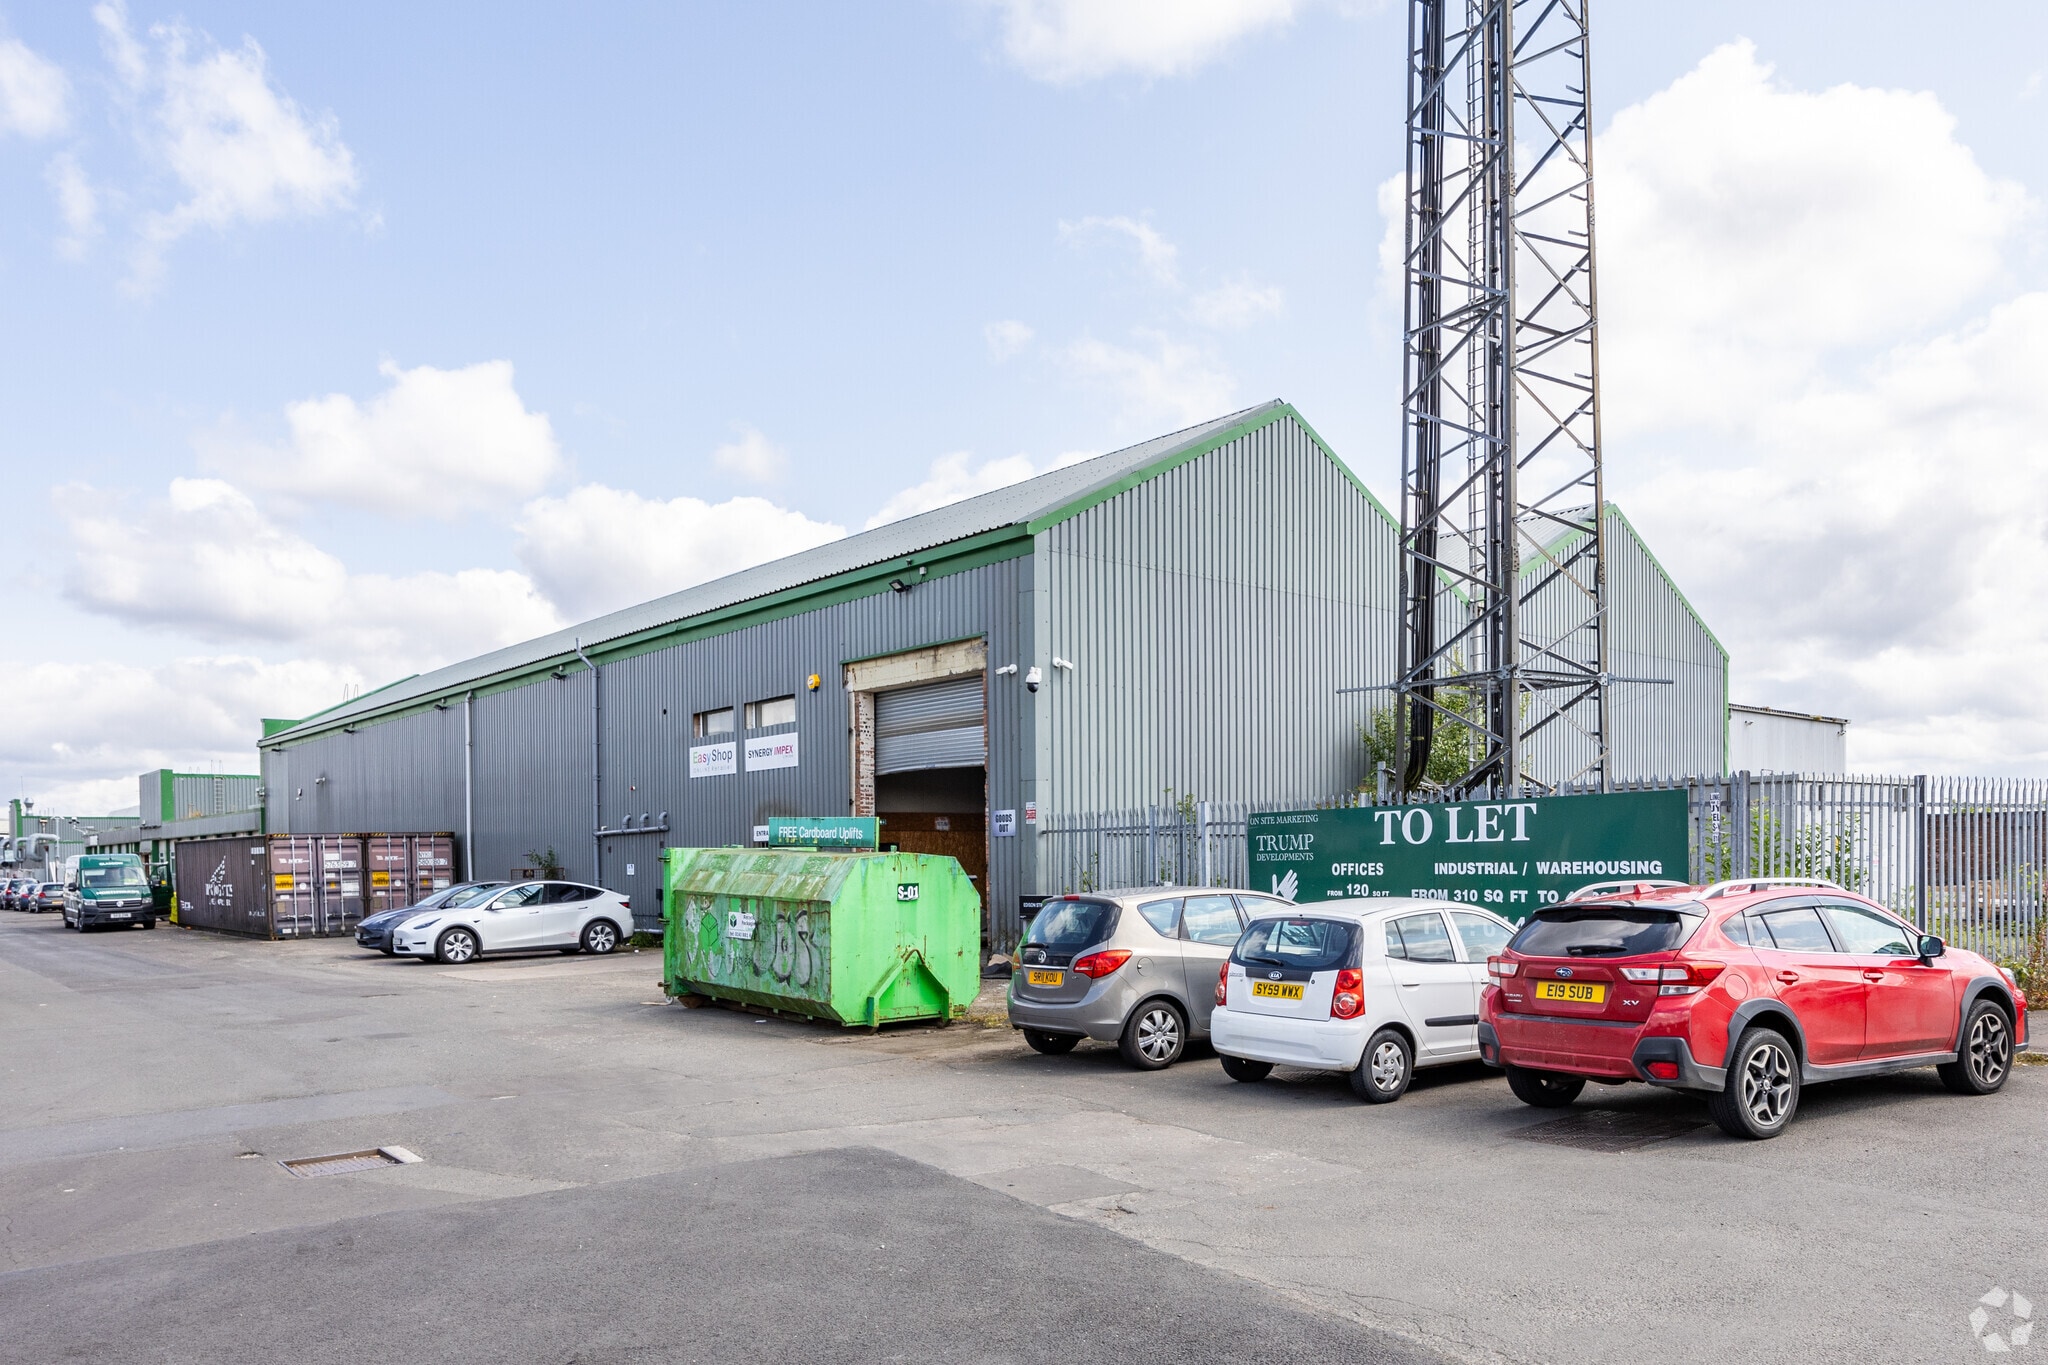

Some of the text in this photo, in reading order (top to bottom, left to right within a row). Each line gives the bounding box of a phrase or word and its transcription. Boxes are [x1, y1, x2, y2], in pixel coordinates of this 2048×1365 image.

[748, 744, 793, 759] SYNERGY IMPEX
[995, 813, 1012, 823] GOODS
[1250, 814, 1318, 826] ON SITE MARKETING
[1374, 803, 1537, 845] TO LET
[779, 827, 863, 840] FREE Cardboard Uplifts
[999, 824, 1009, 832] OUT
[1256, 834, 1314, 851] TRUMP
[1256, 853, 1314, 861] DEVELOPMENTS
[1332, 863, 1384, 876] OFFICES
[1435, 862, 1517, 875] INDUSTRIAL
[1536, 861, 1662, 875] WAREHOUSING
[898, 886, 919, 899] S-01
[1347, 883, 1369, 897] 120
[1411, 889, 1448, 901] FROM
[1454, 889, 1478, 901] 310
[1484, 889, 1503, 904] SQ
[1510, 890, 1528, 903] FT
[1538, 889, 1559, 903] TO
[1256, 983, 1300, 998] SY59 WWX
[1547, 984, 1593, 999] E19 SUB
